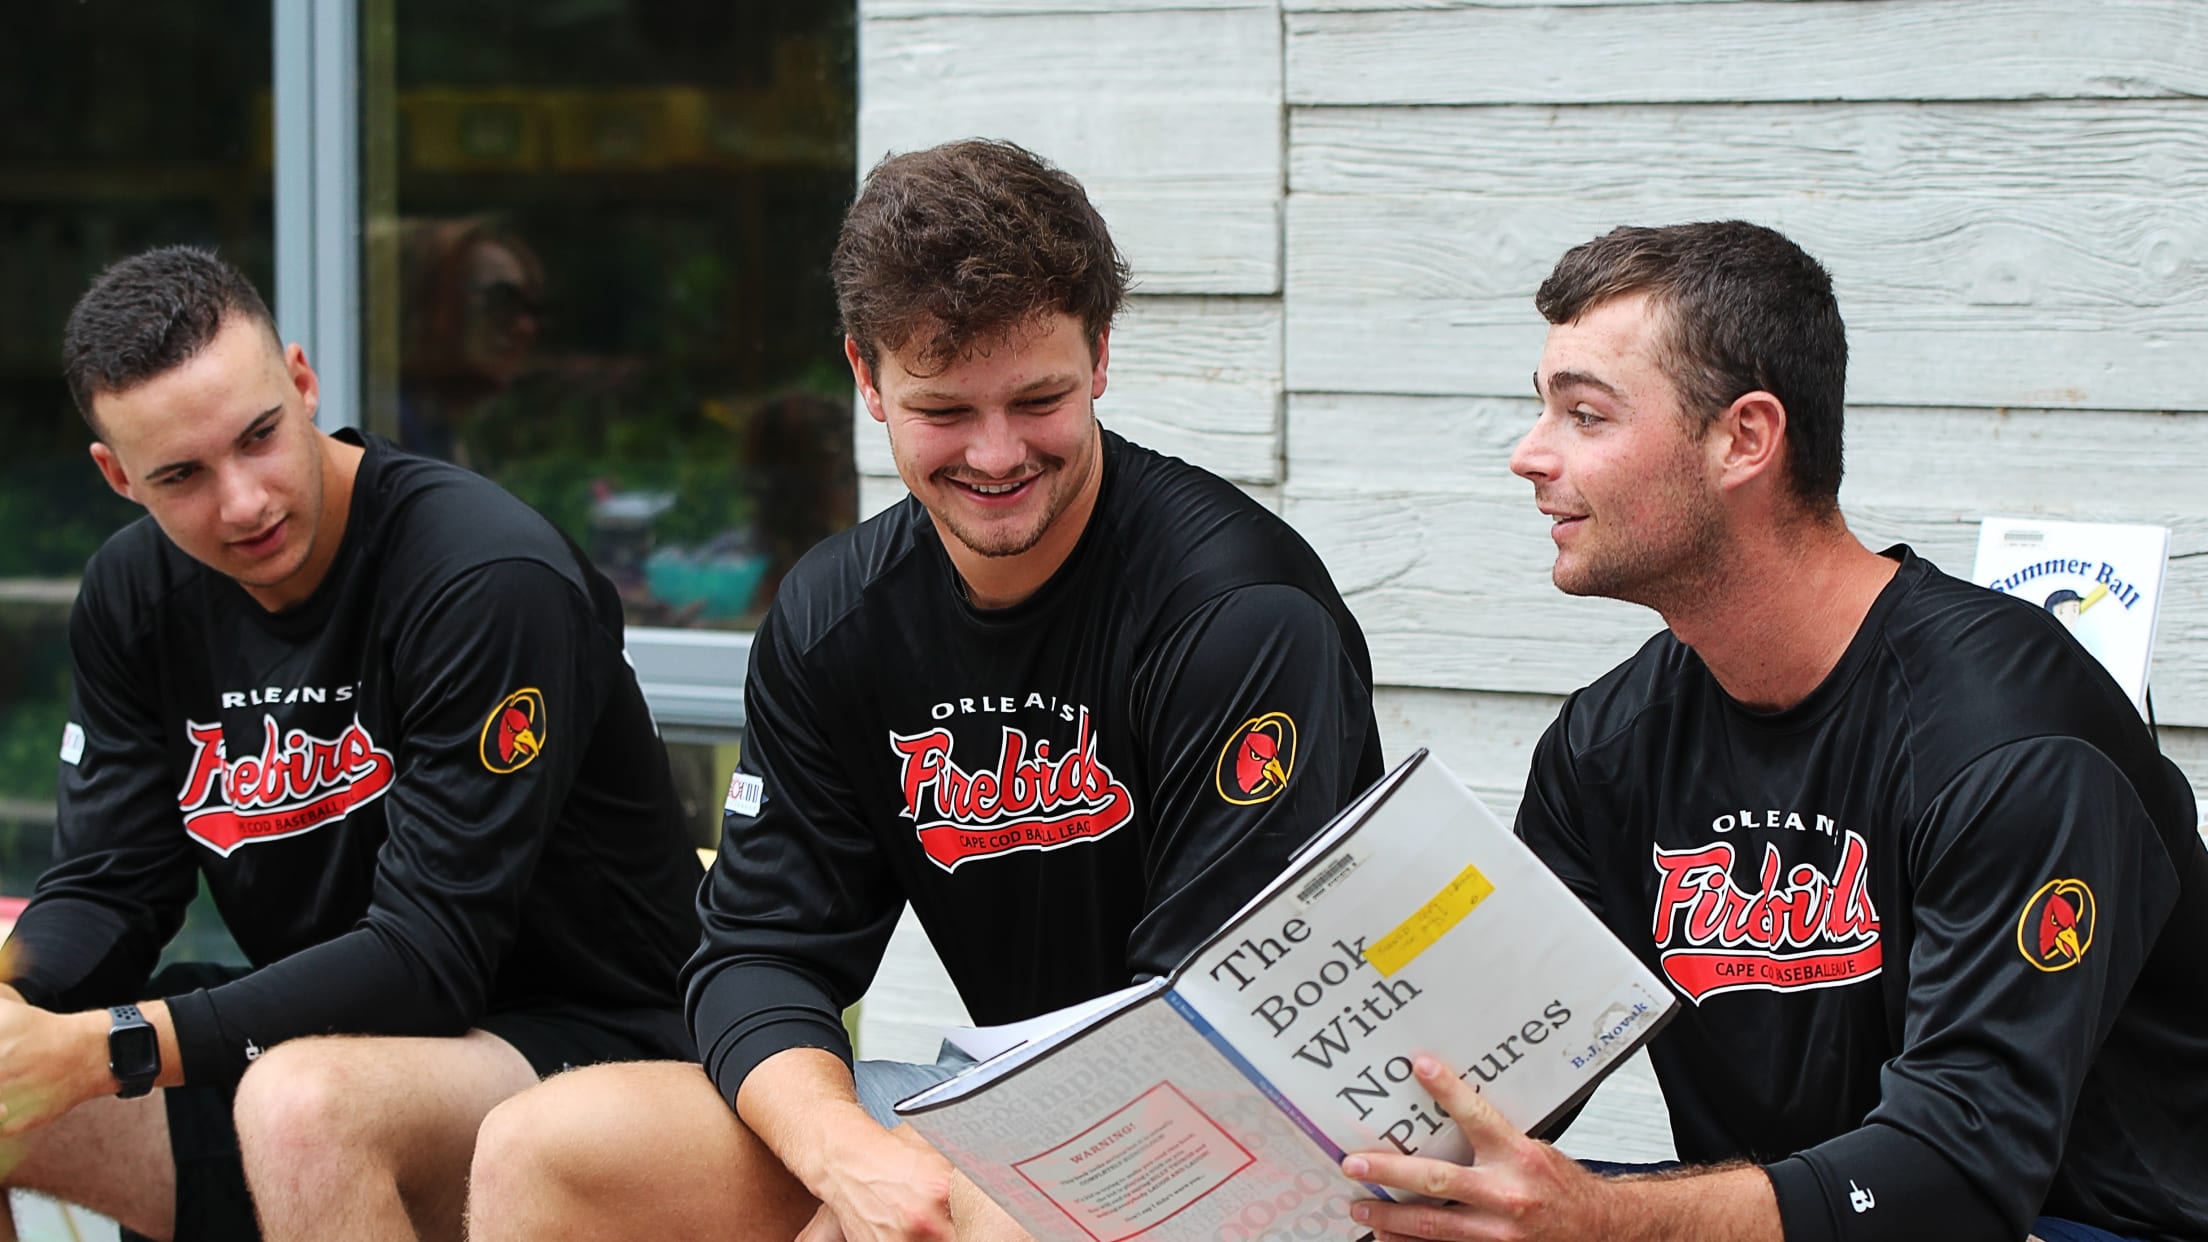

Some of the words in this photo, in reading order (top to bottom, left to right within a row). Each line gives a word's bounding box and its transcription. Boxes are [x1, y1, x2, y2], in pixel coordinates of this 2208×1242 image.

[2094, 561, 2141, 610] Ball
[931, 692, 1075, 722] ORLEAS
[959, 834, 986, 849] CAPE
[989, 830, 1022, 847] COD
[1209, 915, 1312, 992] The
[1715, 962, 1755, 977] CAPE
[1251, 935, 1367, 1038] Book
[1291, 977, 1423, 1069] With
[1336, 1055, 1414, 1121] No
[1378, 999, 1572, 1156] Piures
[1070, 1122, 1136, 1165] WARNING!
